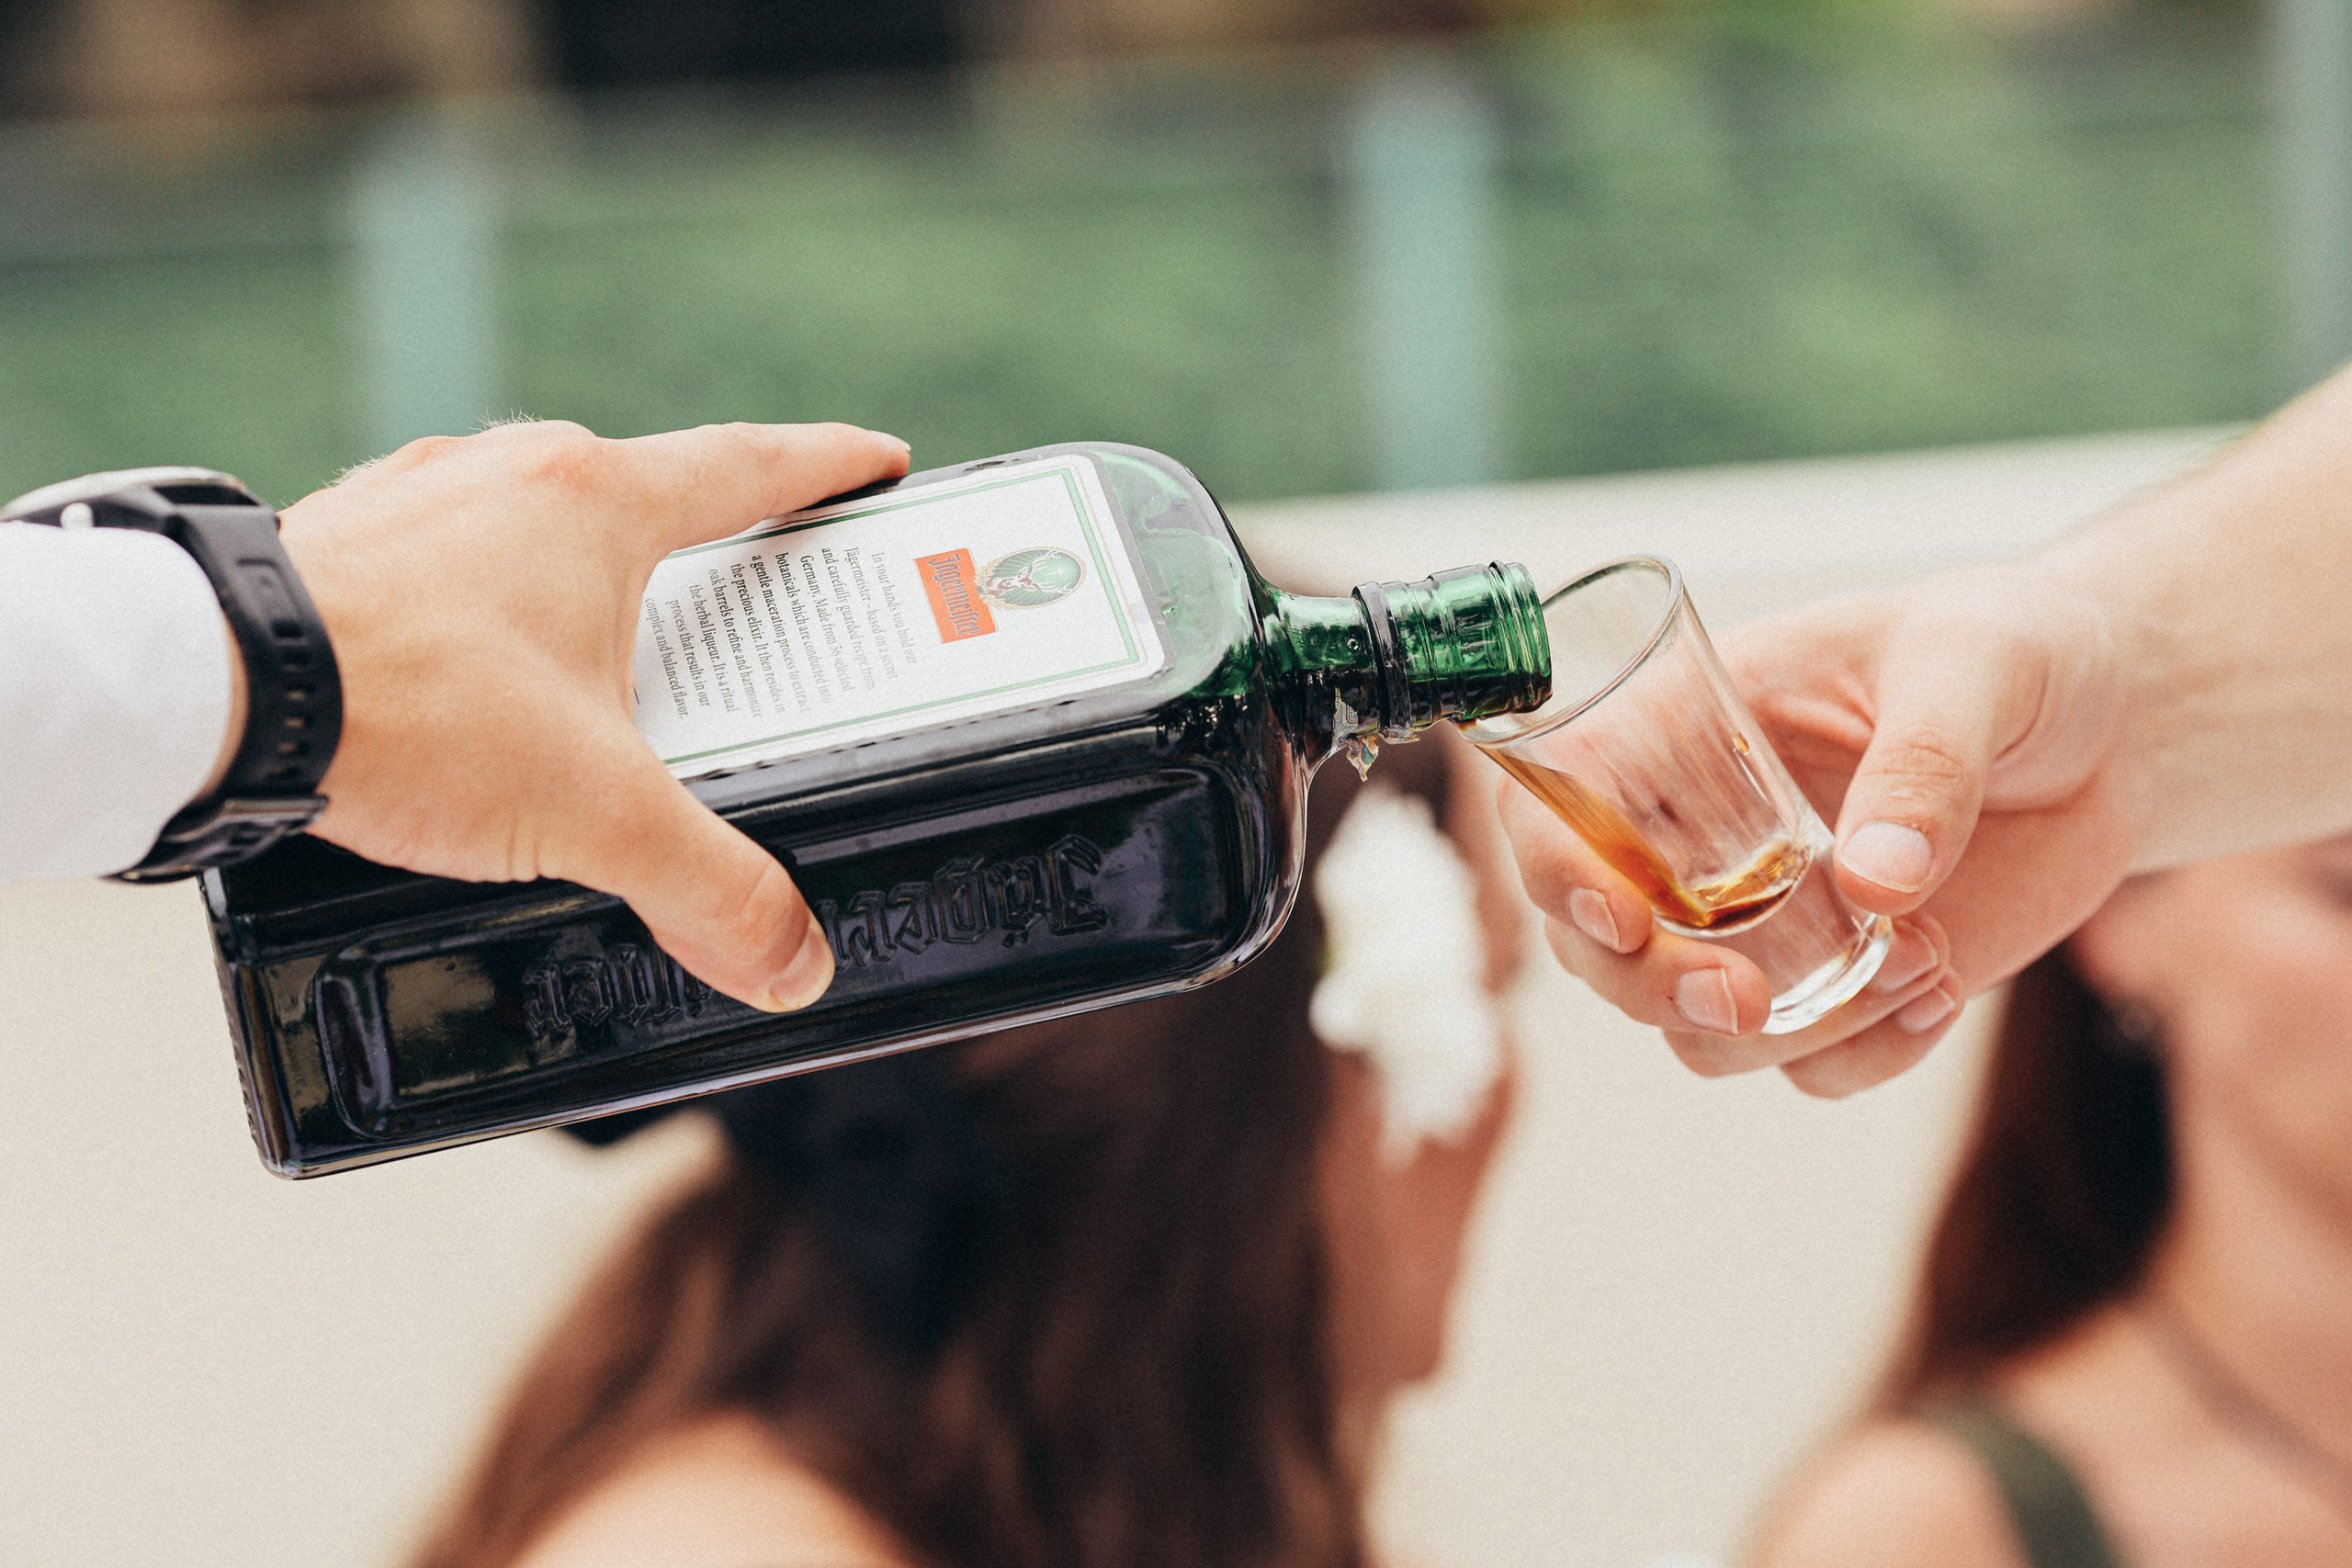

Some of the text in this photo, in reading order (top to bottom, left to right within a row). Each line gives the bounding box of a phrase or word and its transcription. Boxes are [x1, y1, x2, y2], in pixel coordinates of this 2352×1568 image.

[730, 563, 745, 579] the
[750, 561, 773, 588] gentle
[800, 555, 820, 598] Germany.
[843, 547, 871, 601] Jägermeister
[688, 584, 703, 599] the
[731, 579, 754, 616] precious
[927, 554, 979, 636] Jägermeister
[694, 599, 715, 629] herbal
[763, 589, 786, 637] maceration
[814, 598, 832, 623] Made
[821, 547, 876, 690] and carefully guarded recipe from
[865, 609, 886, 635] based
[871, 551, 917, 664] In your hands you hold our
[707, 569, 763, 718] oak barrels to refine and harmonize
[747, 616, 763, 643] elixir.
[775, 552, 831, 704] botanicals which are conducted into
[821, 623, 837, 645] from
[875, 635, 887, 647] on
[645, 598, 689, 718] complex and balanced flavor.
[665, 599, 710, 706] process that results in our
[701, 627, 720, 663] liqueur.
[775, 638, 795, 670] process
[713, 662, 727, 671] It
[716, 671, 725, 681] is
[758, 651, 773, 671] then
[788, 670, 800, 680] to
[834, 658, 856, 692] selected
[720, 687, 740, 713] ritual
[764, 672, 784, 703] resides
[792, 681, 811, 713] extract
[775, 703, 786, 714] in
